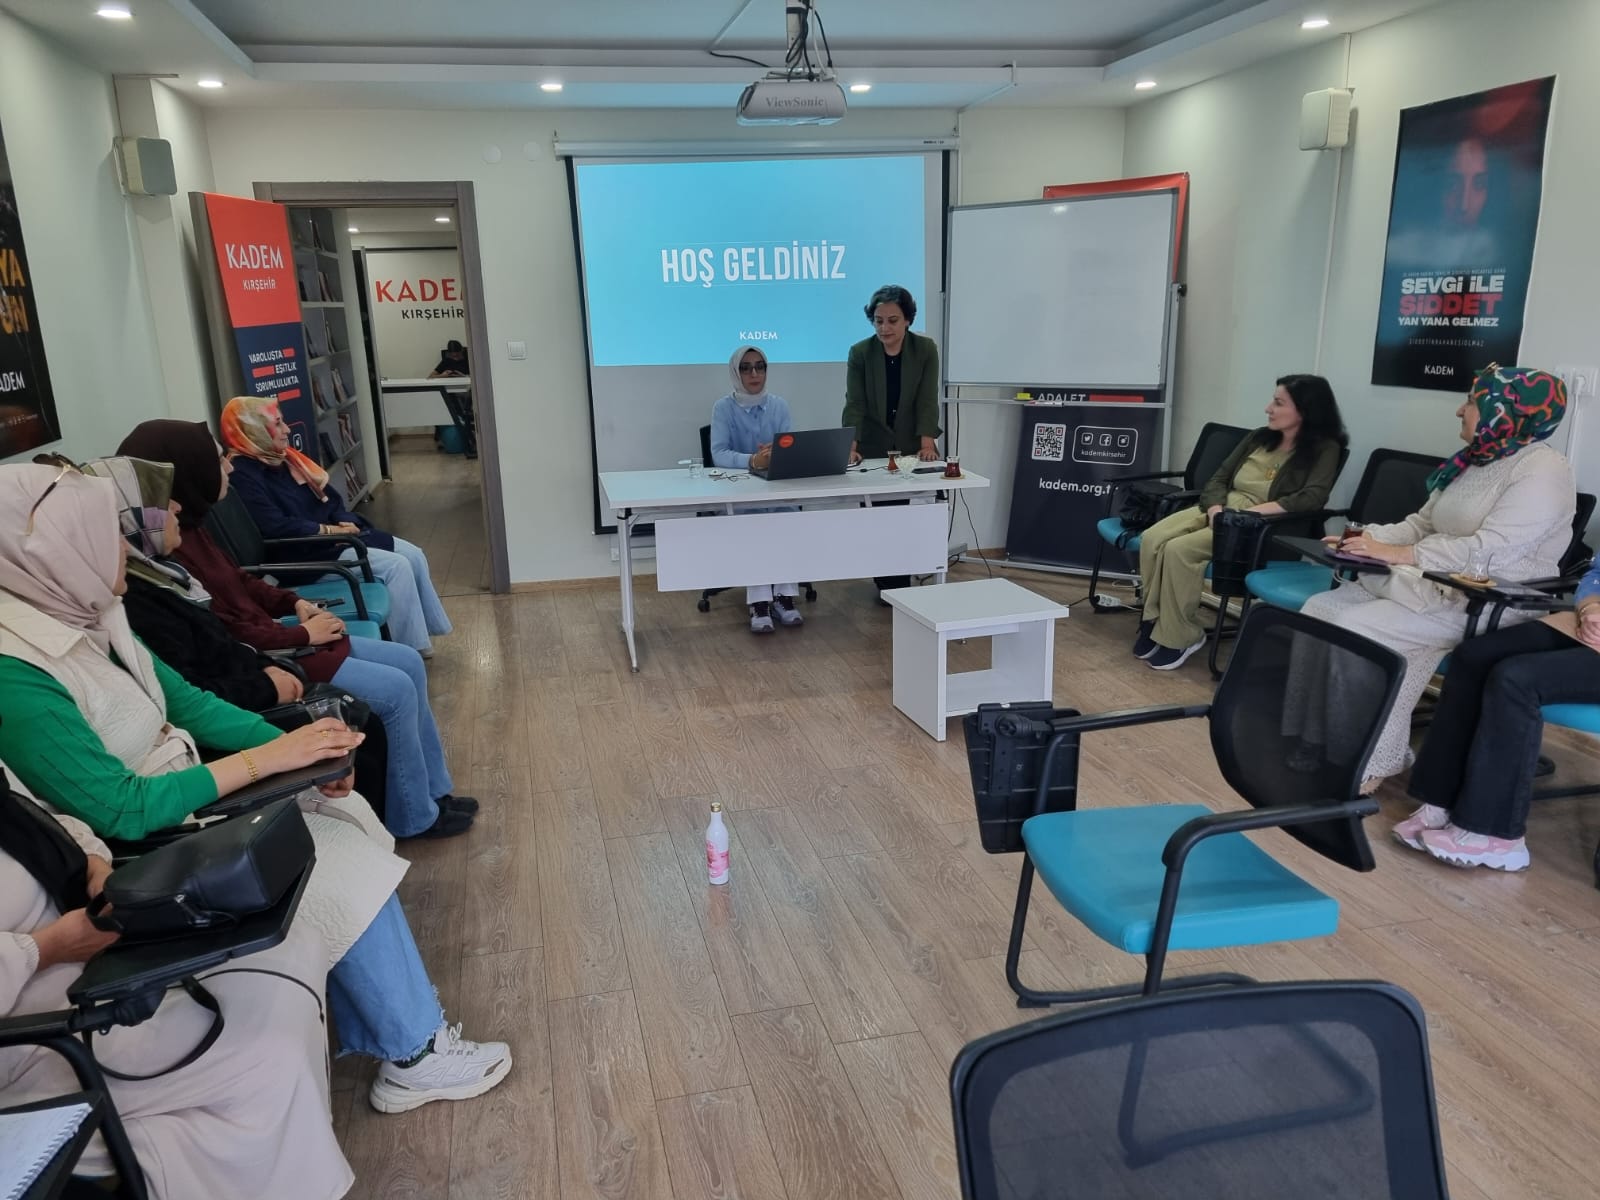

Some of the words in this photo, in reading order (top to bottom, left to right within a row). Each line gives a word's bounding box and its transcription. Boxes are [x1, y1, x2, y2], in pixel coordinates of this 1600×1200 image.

[766, 96, 824, 107] ViewSonic
[225, 242, 284, 270] KADEM
[661, 247, 715, 288] HOŞ
[723, 240, 847, 282] GELDİNİZ
[242, 276, 277, 293] KIRŞEHİR
[375, 278, 464, 303] KADE
[401, 305, 464, 320] KIRŞEHİR
[1399, 317, 1419, 326] YAN
[1421, 317, 1449, 326] YANA
[1452, 317, 1498, 327] GELMEZ
[739, 331, 778, 340] KADEM
[248, 349, 283, 364] VAROLUŞTA
[1424, 365, 1454, 376] KADEM
[1039, 477, 1119, 497] kadem.org.t
